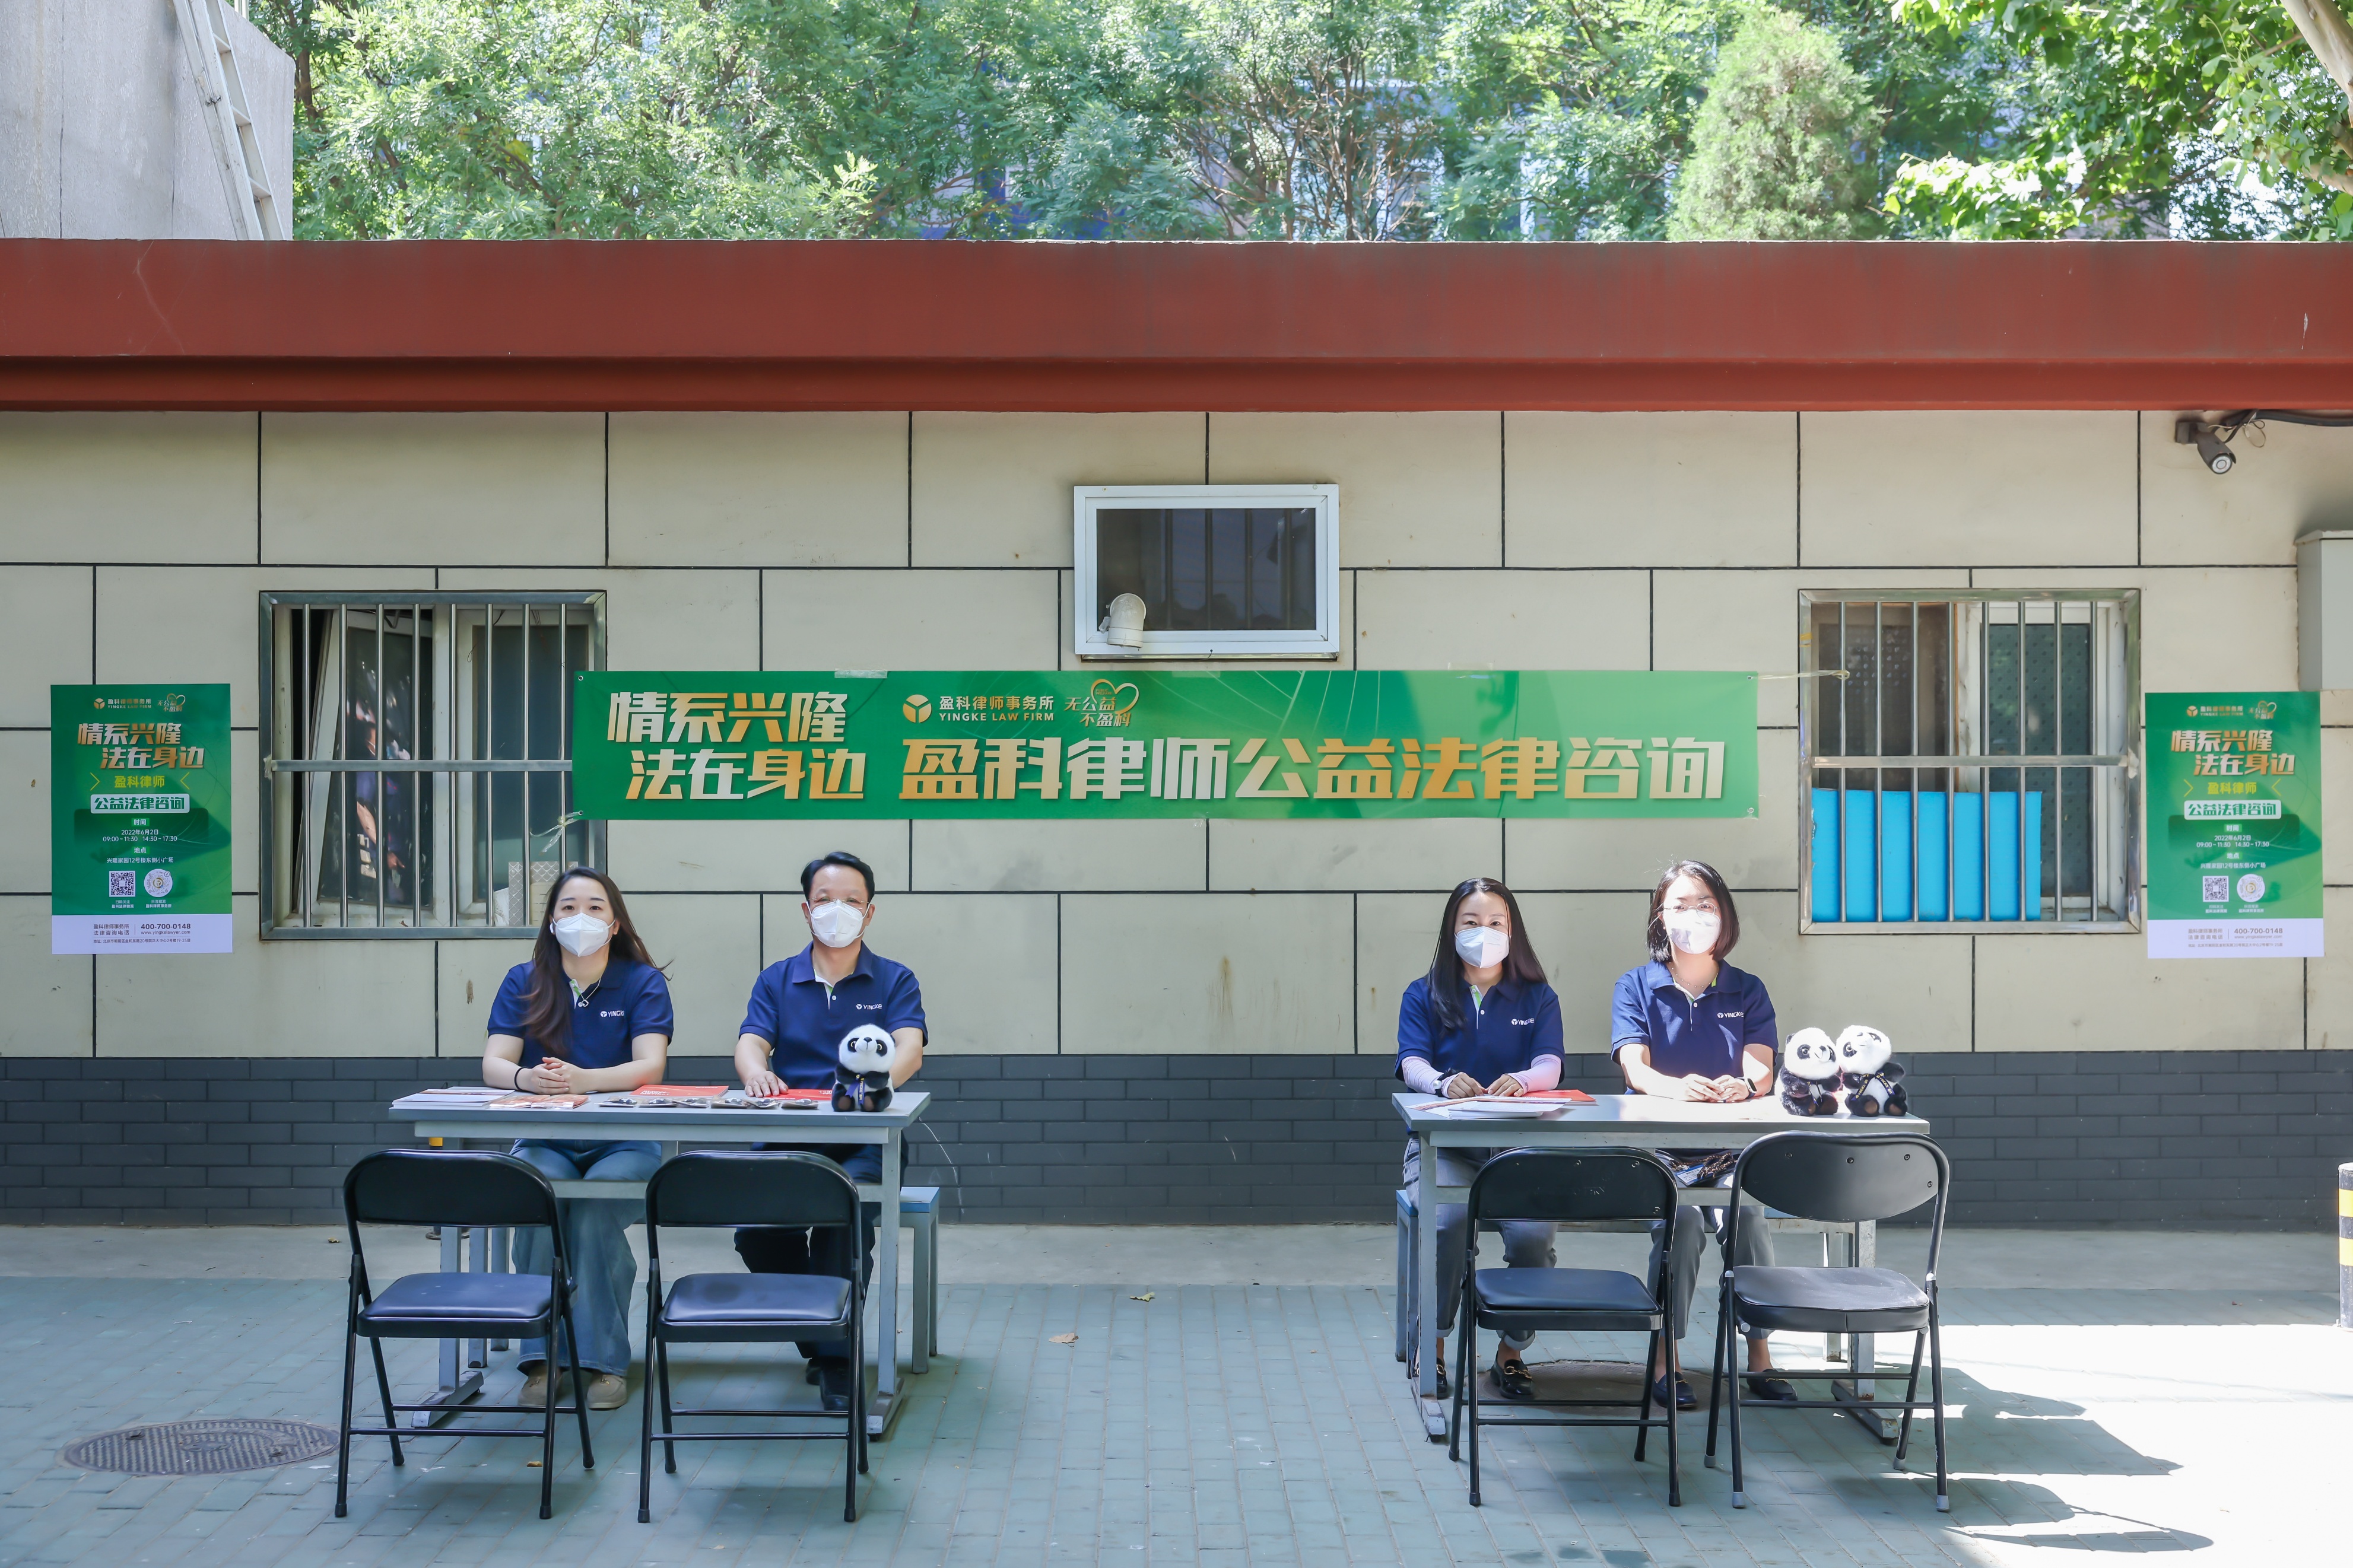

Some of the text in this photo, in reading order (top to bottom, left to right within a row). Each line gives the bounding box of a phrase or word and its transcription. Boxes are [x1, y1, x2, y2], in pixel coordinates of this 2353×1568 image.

[939, 695, 1055, 711] 盈科律师事务所
[1063, 696, 1116, 711] 无公益
[606, 691, 848, 743] 情系兴隆
[939, 713, 1055, 721] YINGKE LAW FIRM
[77, 722, 182, 745] 情系兴隆
[2171, 730, 2273, 752] 情系兴隆
[100, 746, 205, 769] 法在身边
[2193, 753, 2295, 776] 法在身边
[625, 748, 865, 800] 法在身边
[898, 736, 1726, 801] 盈科律师公益法律咨询
[114, 775, 165, 788] 盈科律师
[2208, 781, 2257, 794] 盈科律师
[94, 797, 185, 810] 公益法律咨询
[2188, 803, 2276, 816] 公益法律咨询
